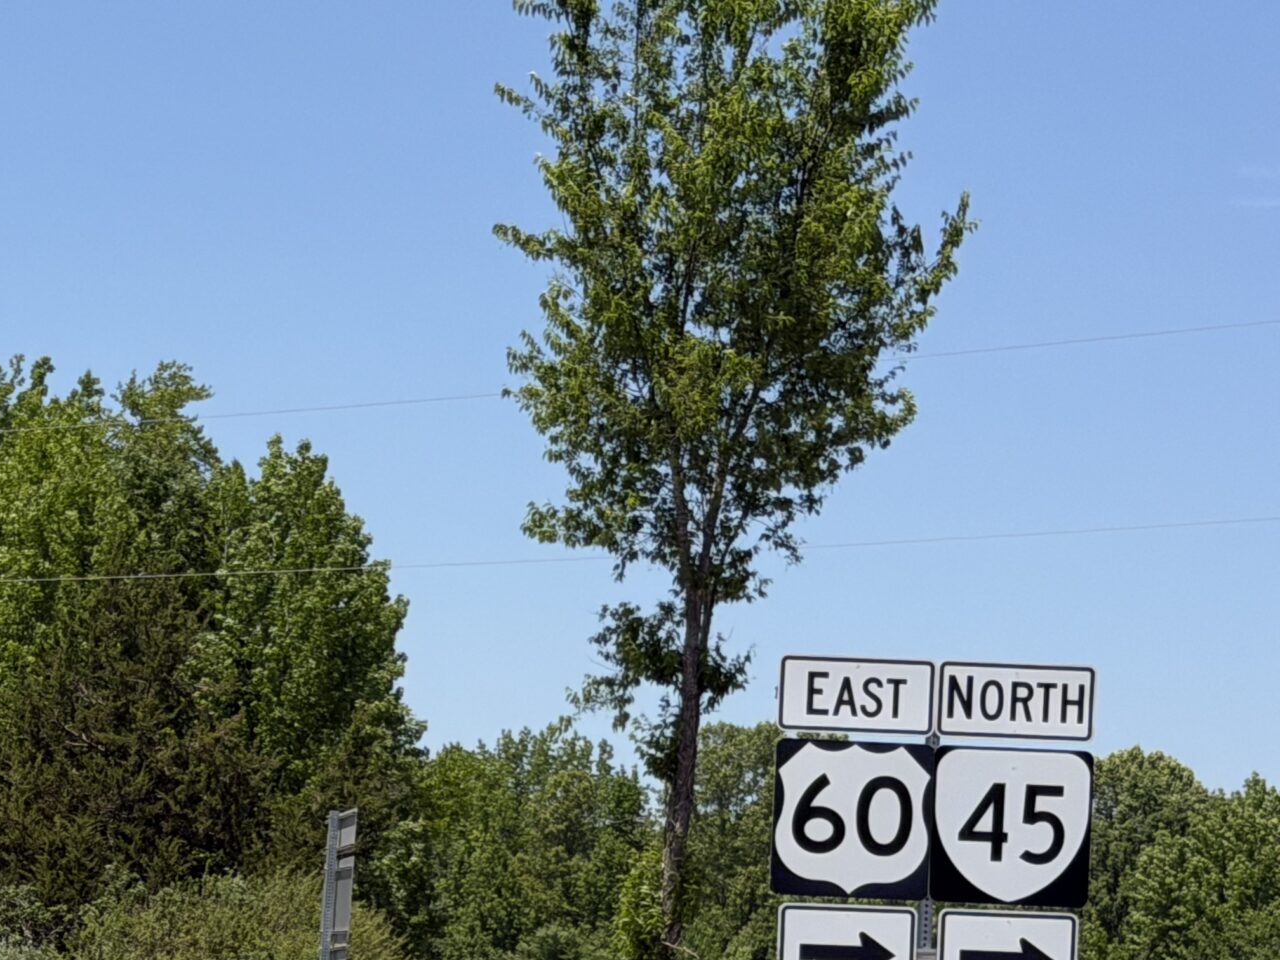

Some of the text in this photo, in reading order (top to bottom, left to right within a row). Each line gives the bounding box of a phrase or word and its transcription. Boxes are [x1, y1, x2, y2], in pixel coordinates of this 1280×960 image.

[805, 671, 908, 719] EAST
[946, 675, 1085, 724] NORTH
[792, 773, 913, 857] 60
[957, 782, 1065, 865] 45
